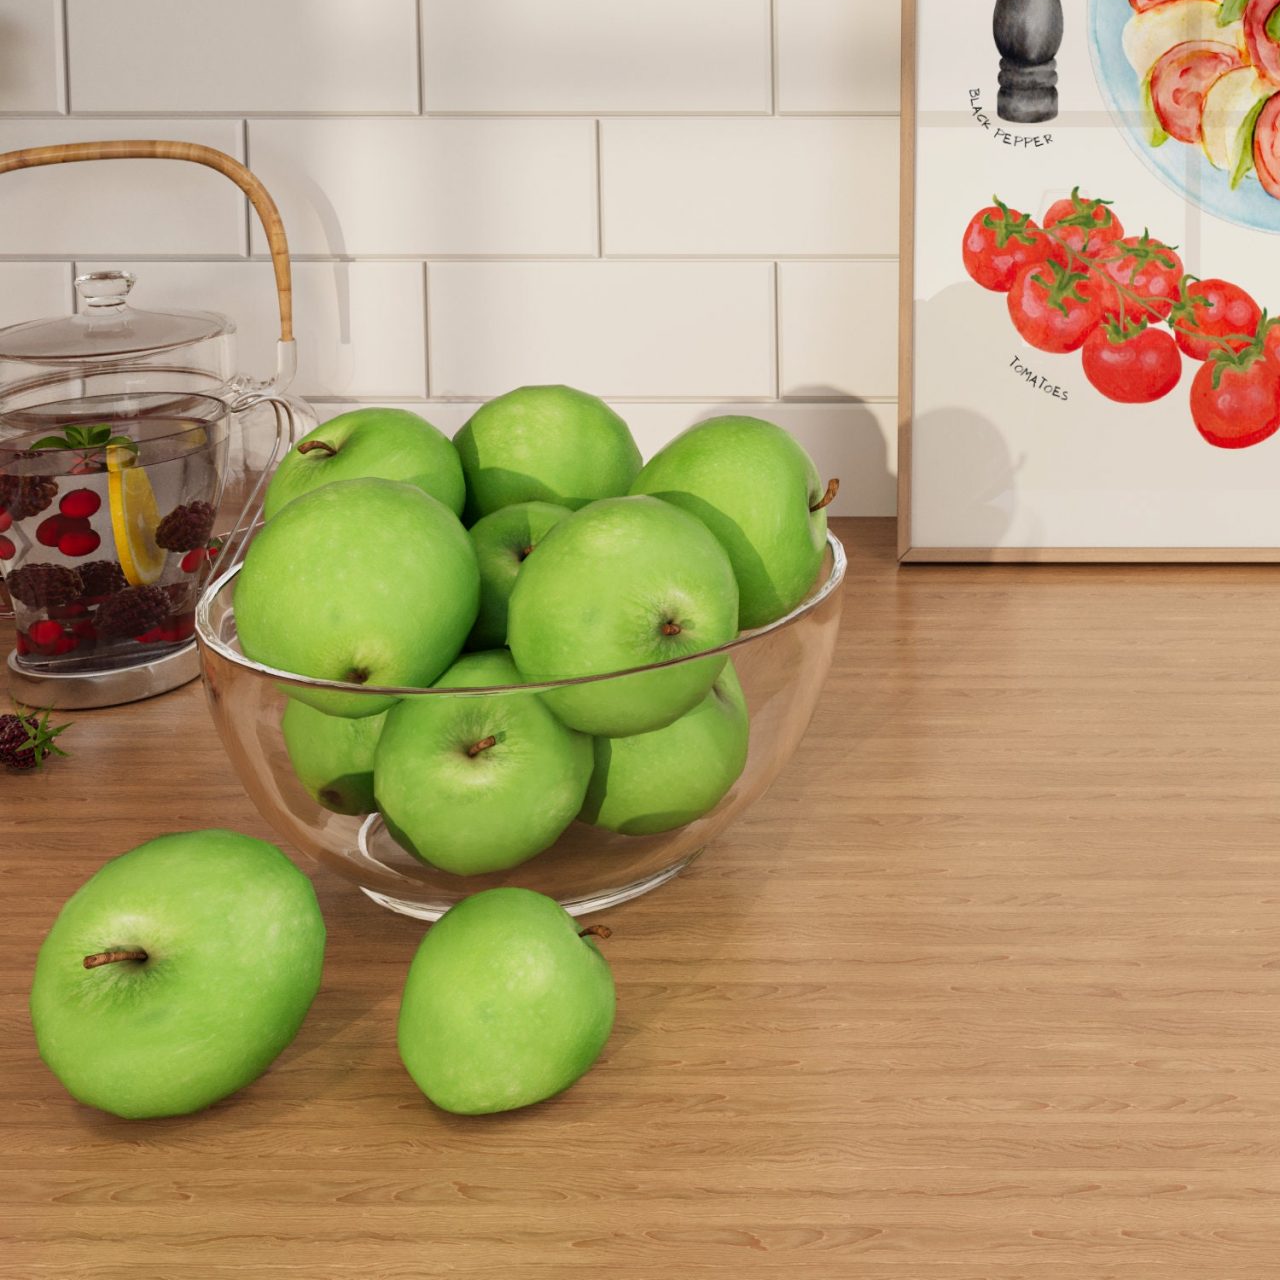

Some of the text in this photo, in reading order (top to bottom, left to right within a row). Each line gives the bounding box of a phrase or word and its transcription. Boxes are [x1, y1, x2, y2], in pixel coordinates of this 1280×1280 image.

[969, 88, 1054, 149] BLACK PEPPER
[1009, 355, 1069, 401] TOMATOES
